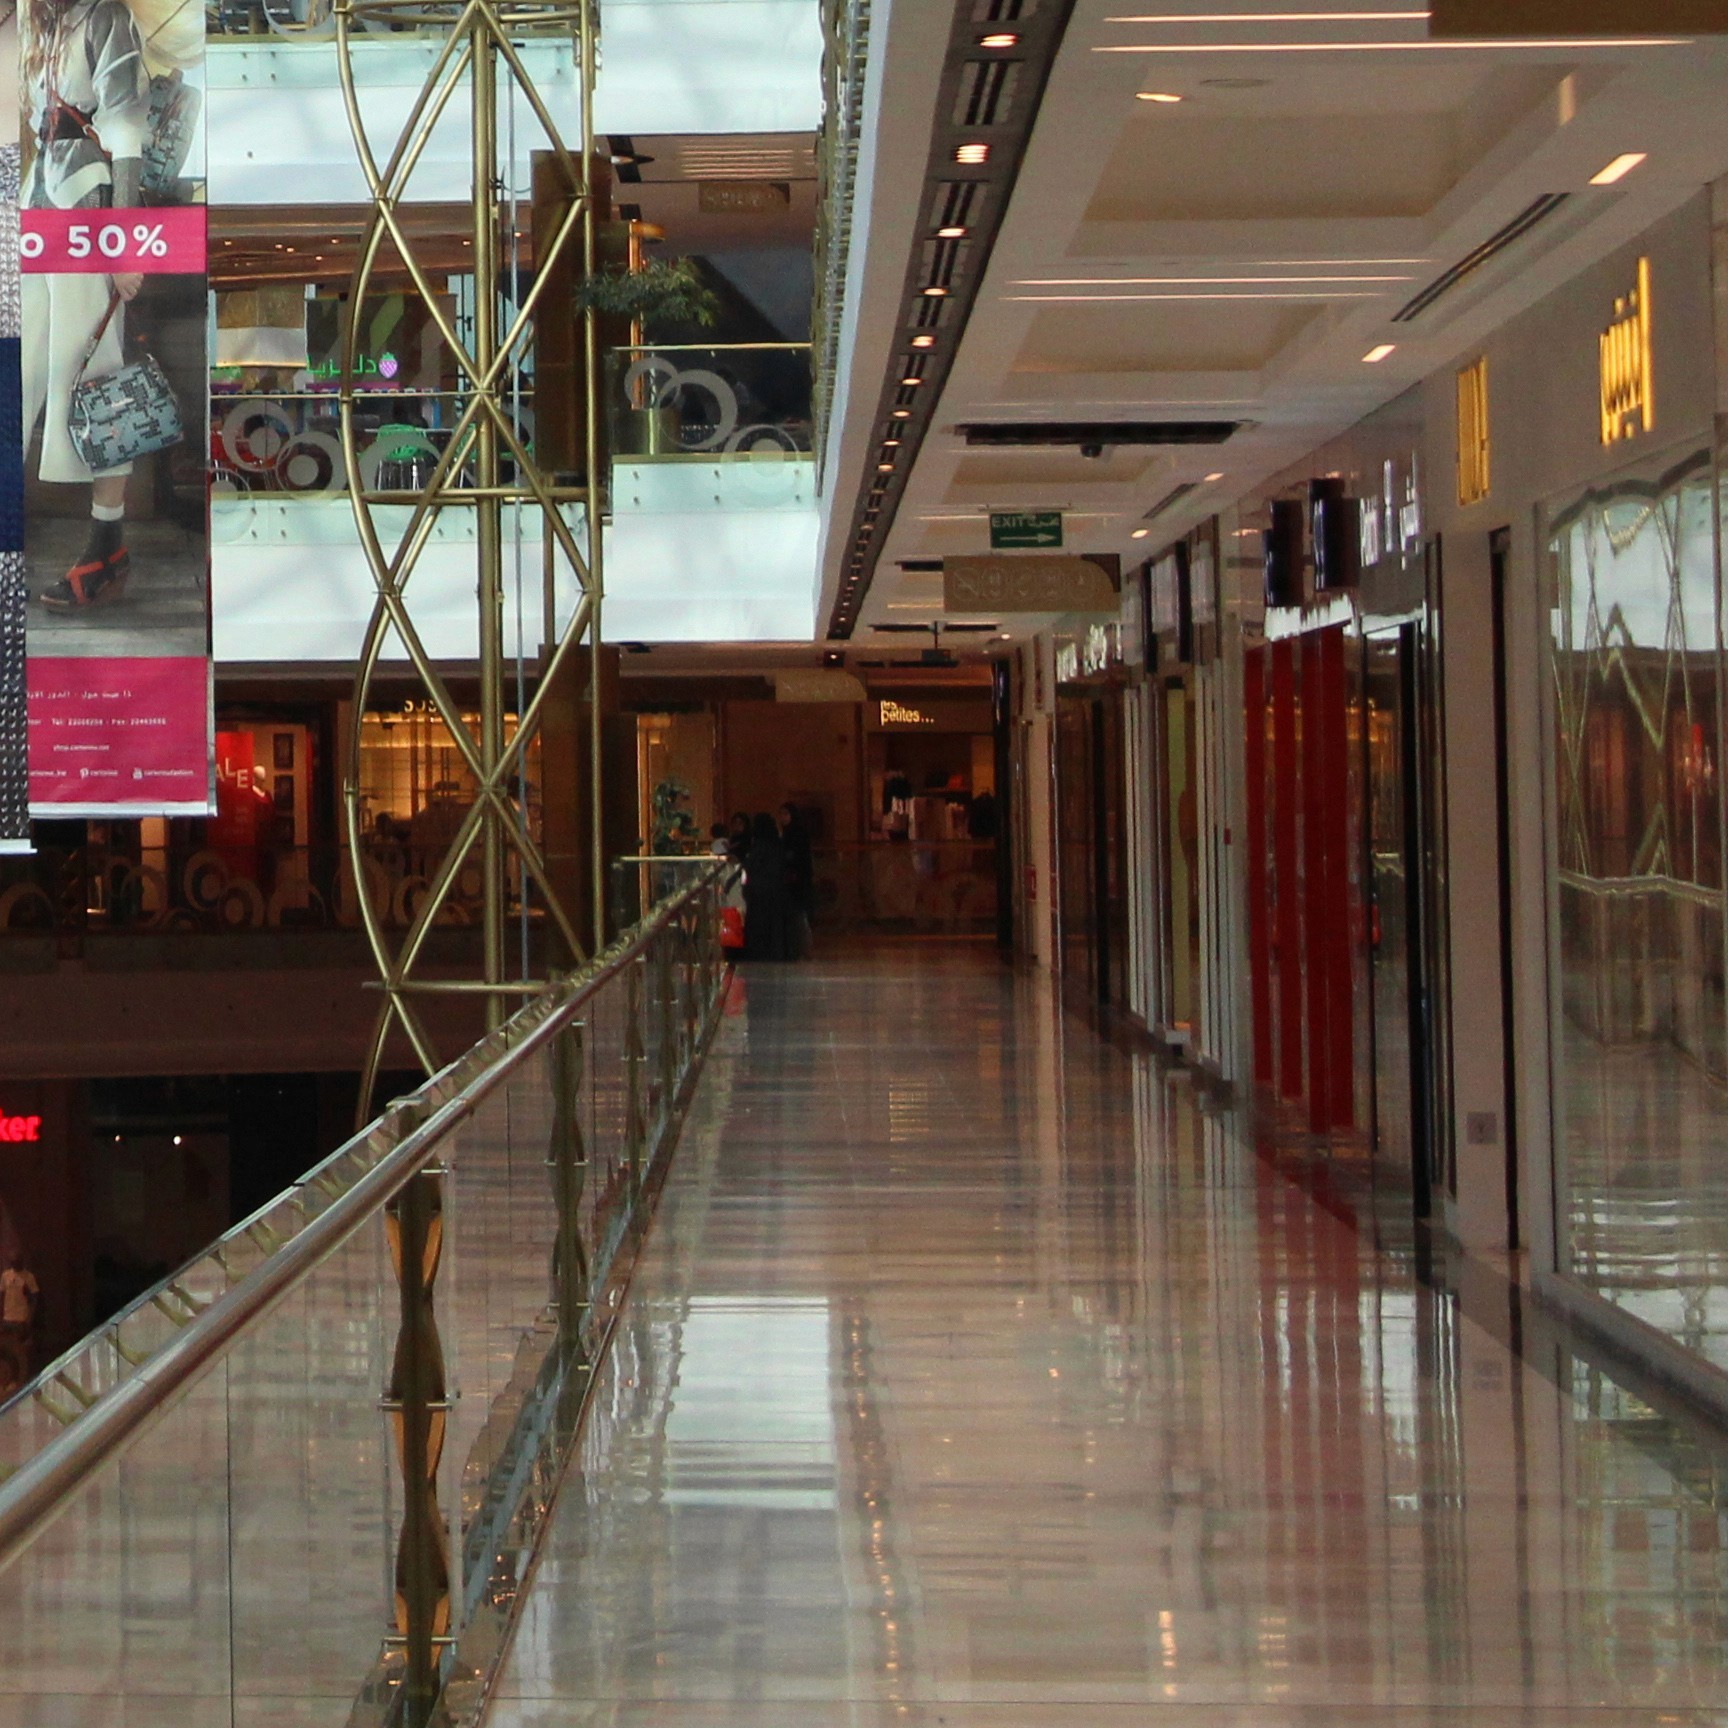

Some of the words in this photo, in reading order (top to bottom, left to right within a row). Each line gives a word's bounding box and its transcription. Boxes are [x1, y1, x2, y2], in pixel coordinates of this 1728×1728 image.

[20, 232, 44, 258] o
[67, 224, 167, 258] 50%
[991, 515, 1024, 528] EXIT
[215, 757, 249, 788] ALE
